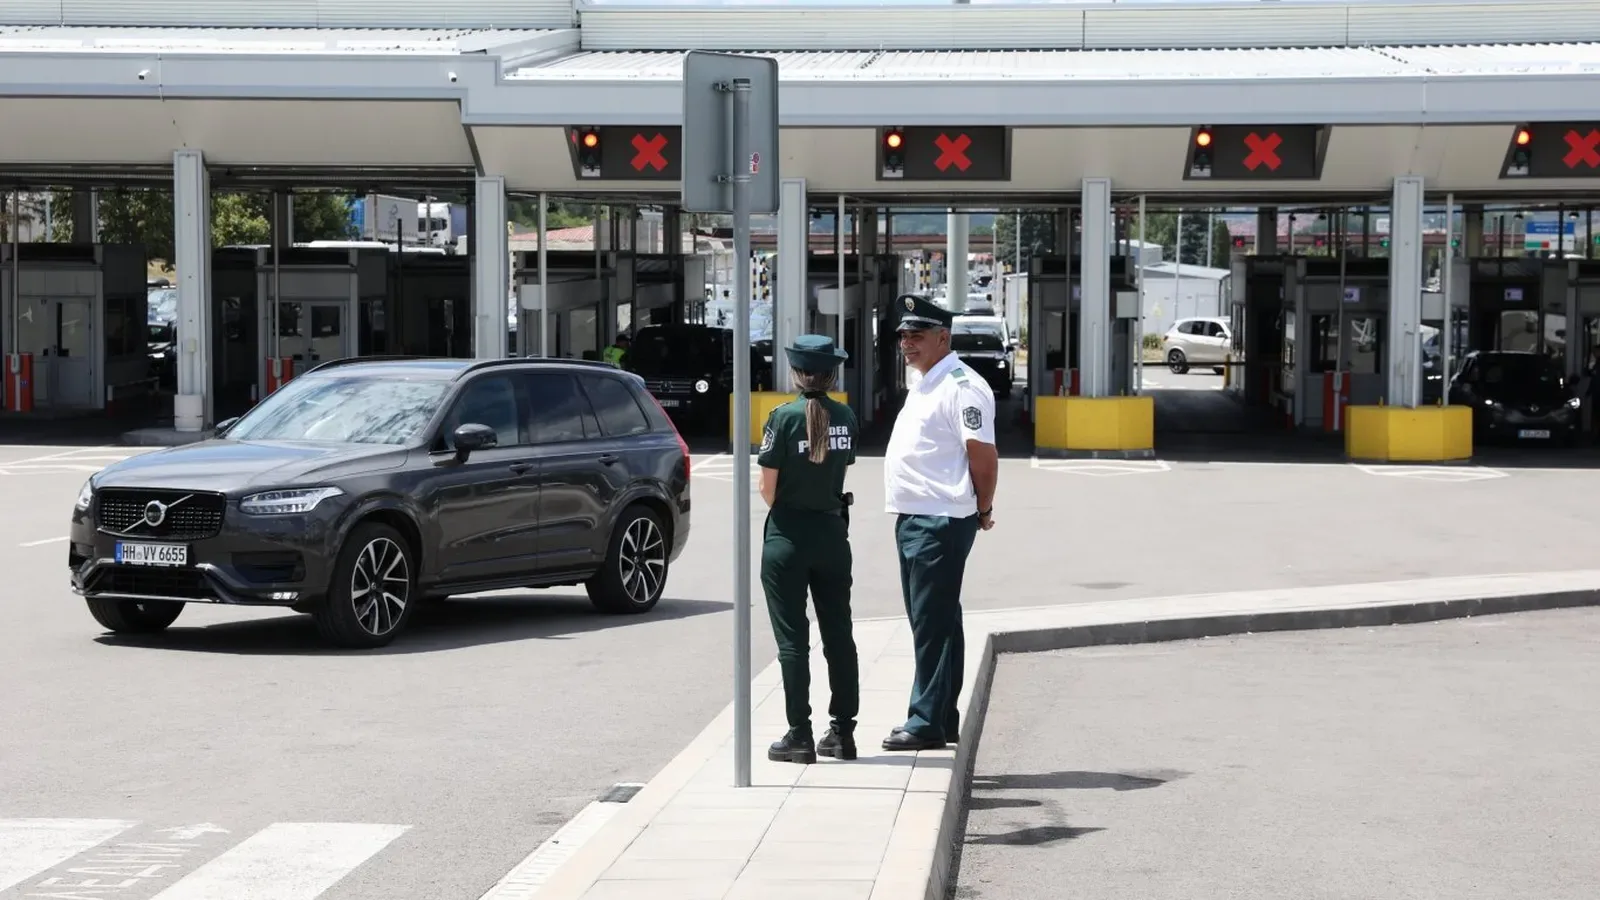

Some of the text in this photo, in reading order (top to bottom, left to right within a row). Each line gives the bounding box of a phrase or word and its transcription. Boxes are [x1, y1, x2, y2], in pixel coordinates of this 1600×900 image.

[122, 545, 185, 562] HH VY 6655
